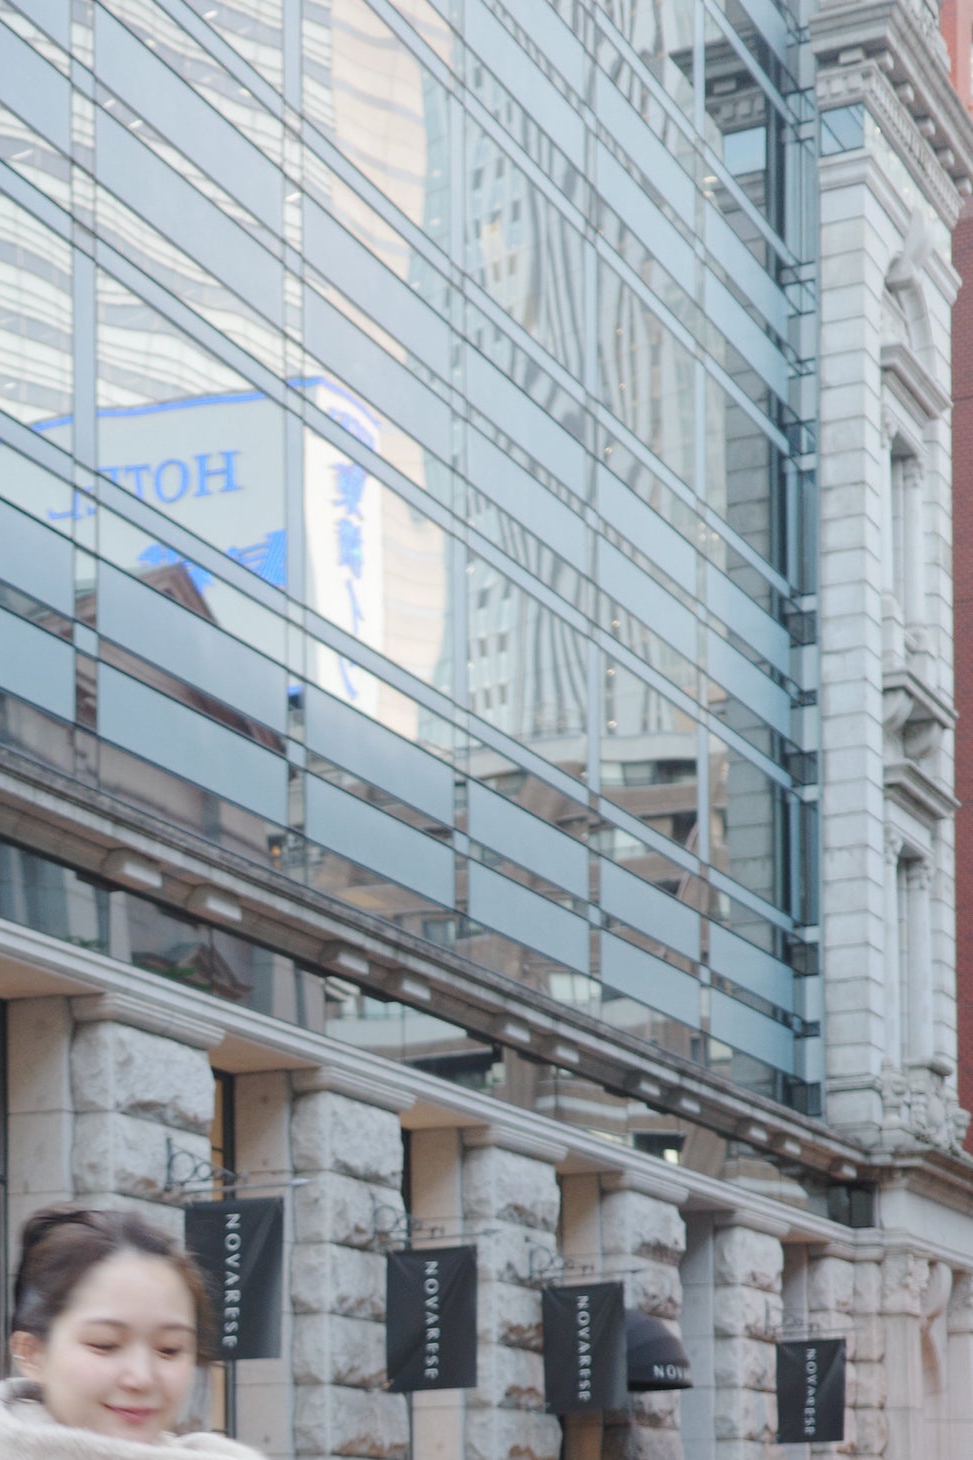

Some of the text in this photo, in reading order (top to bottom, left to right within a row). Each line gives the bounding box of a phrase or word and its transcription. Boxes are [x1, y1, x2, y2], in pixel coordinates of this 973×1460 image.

[222, 1213, 241, 1348] NOVARESE
[424, 1261, 440, 1379] NOVARESE
[577, 1295, 592, 1402] NOVARESE
[805, 1349, 818, 1436] NOVARESE
